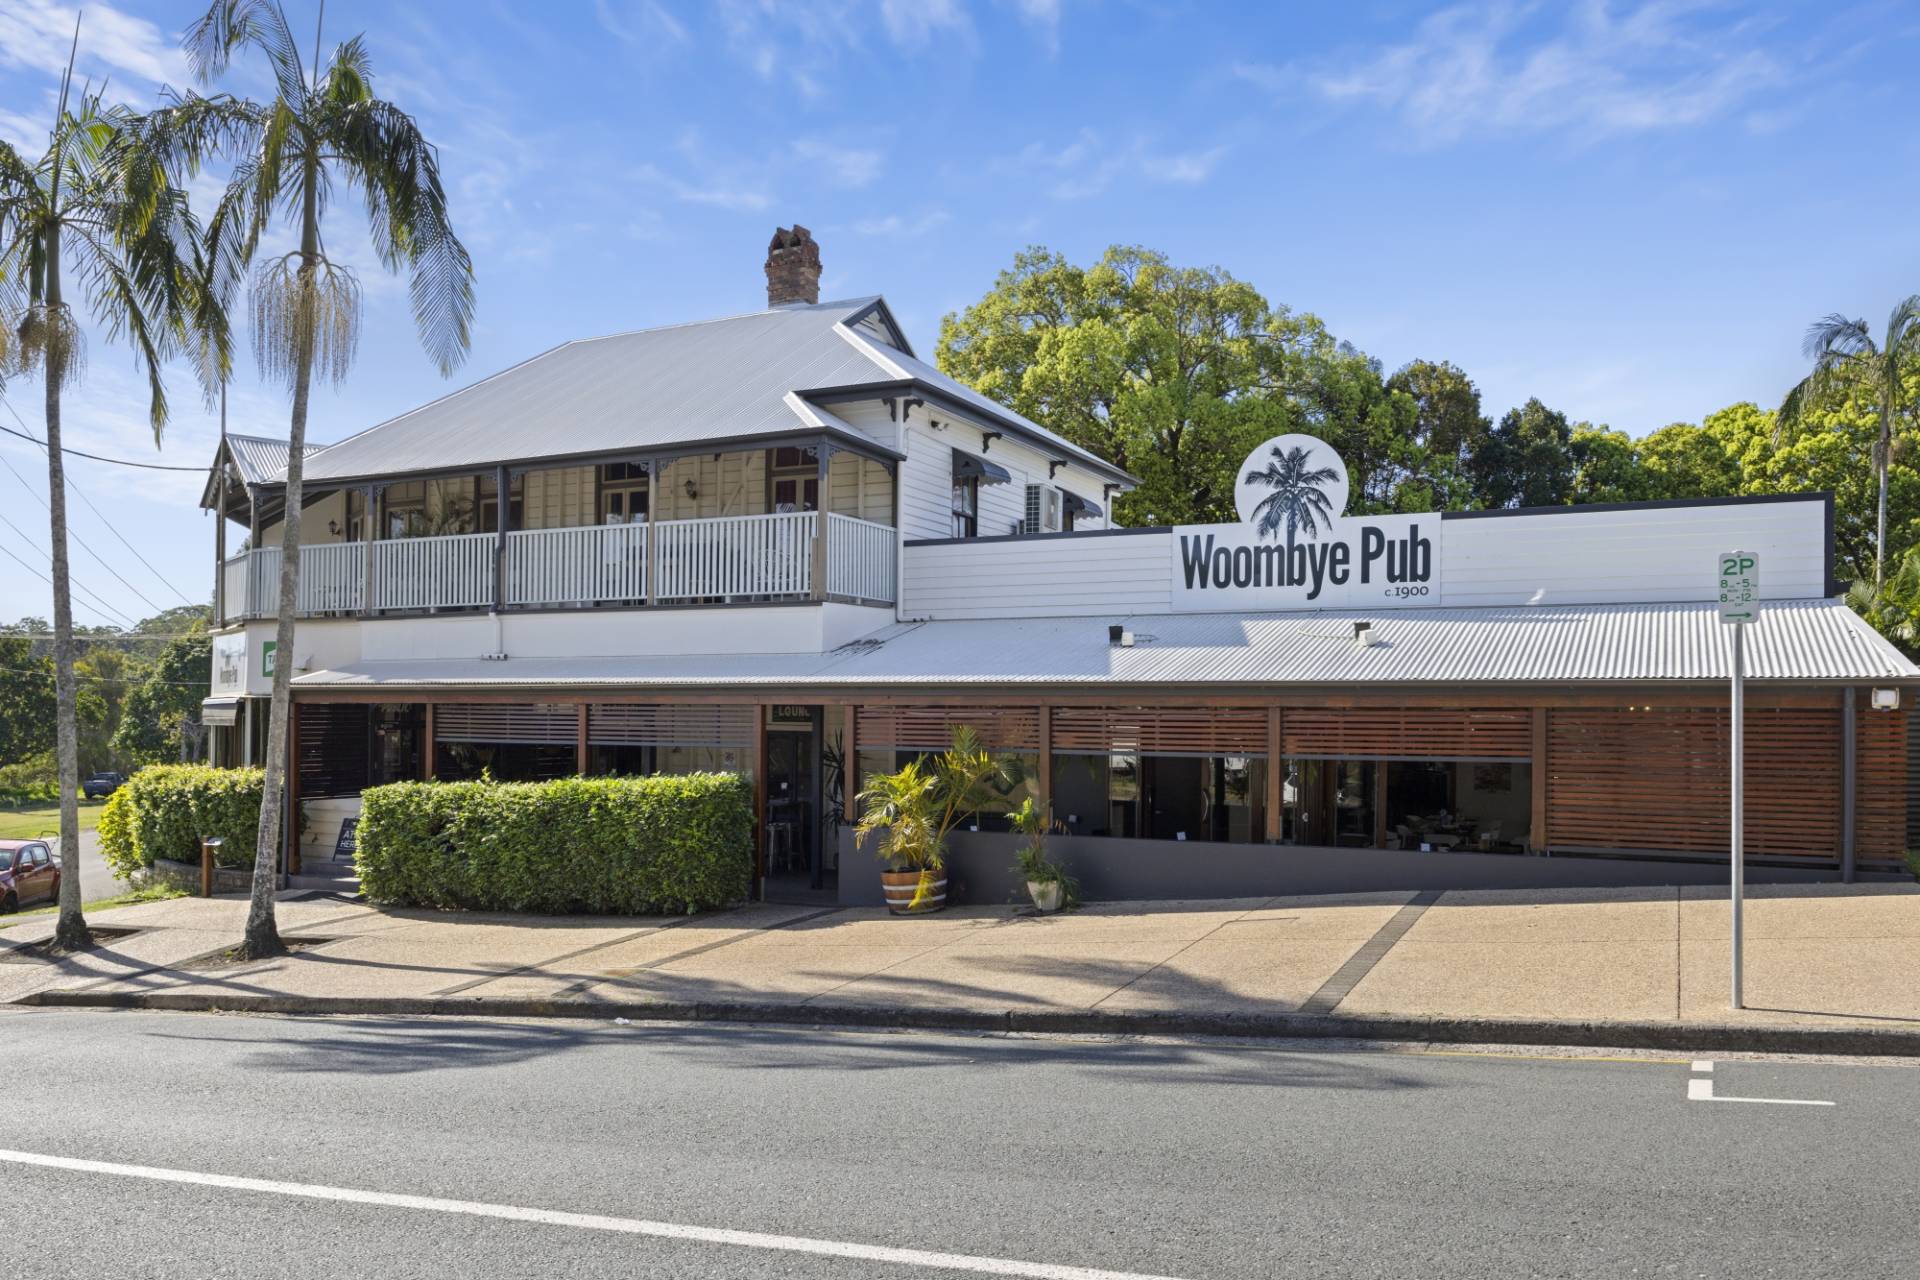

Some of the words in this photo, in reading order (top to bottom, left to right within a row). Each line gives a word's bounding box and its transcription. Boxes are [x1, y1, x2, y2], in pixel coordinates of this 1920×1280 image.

[1180, 534, 1350, 600] Woombye
[1361, 524, 1431, 584] Pub
[1722, 558, 1755, 576] 2P
[1384, 586, 1429, 599] c.1900
